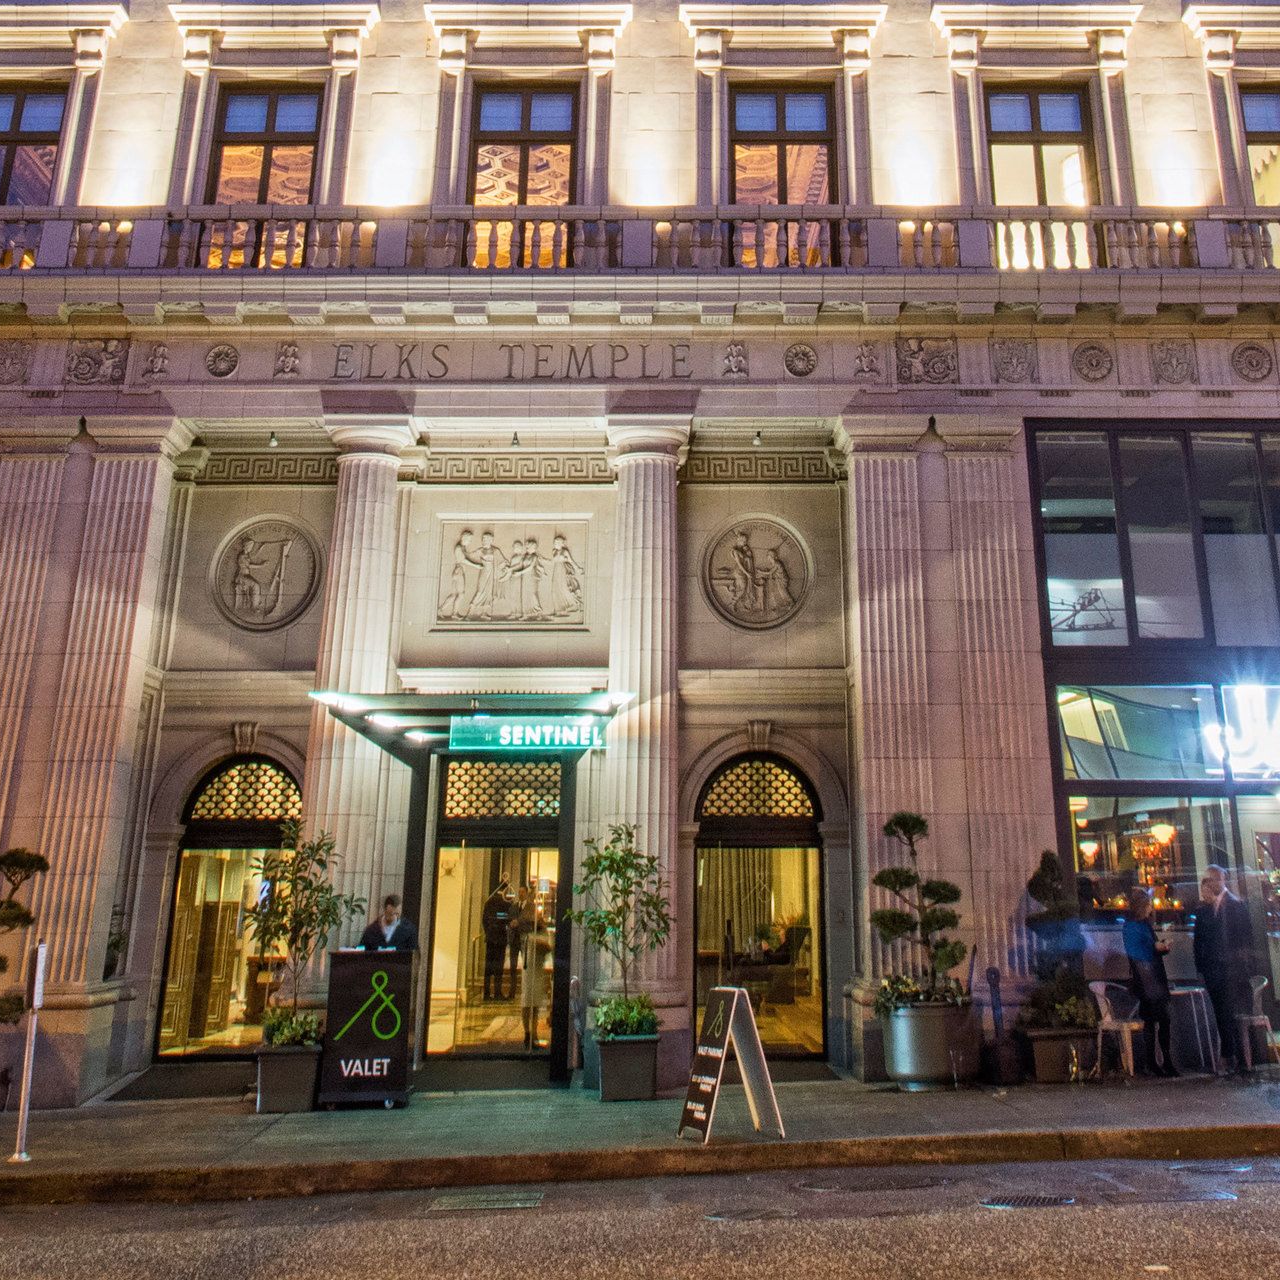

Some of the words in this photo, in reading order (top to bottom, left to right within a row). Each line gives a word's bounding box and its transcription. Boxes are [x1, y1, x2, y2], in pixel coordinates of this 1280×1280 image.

[329, 343, 451, 380] ELKS
[498, 343, 696, 380] TEMPLE
[499, 724, 604, 747] SENTINEL
[339, 1057, 390, 1077] VALET
